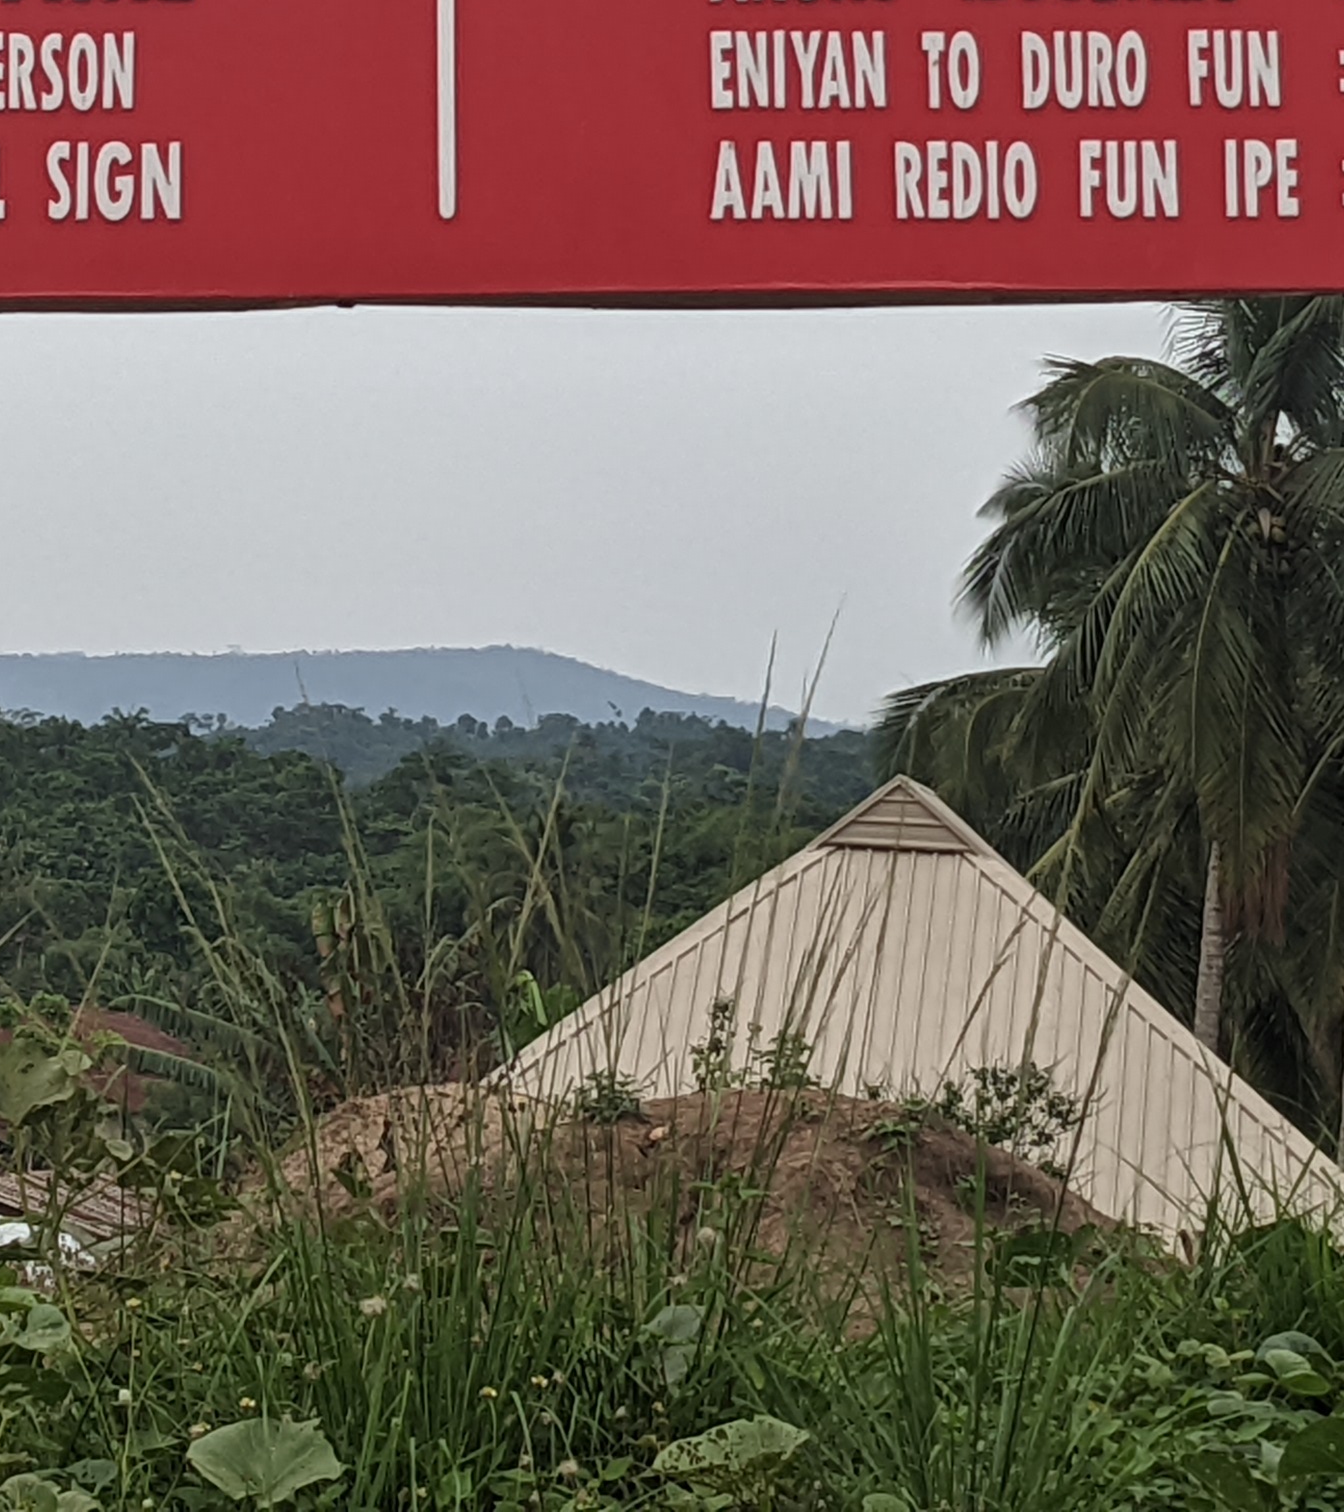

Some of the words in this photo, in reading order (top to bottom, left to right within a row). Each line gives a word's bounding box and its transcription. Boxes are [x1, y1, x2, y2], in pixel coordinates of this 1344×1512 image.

[710, 30, 887, 109] ENIYAN
[921, 31, 981, 110] TO
[1021, 30, 1148, 110] DURO
[1188, 29, 1281, 109] FUN
[46, 141, 182, 222] SIGN
[710, 140, 853, 220] AAMI
[894, 140, 1038, 220] REDIO
[1080, 139, 1180, 219] FUN
[1225, 139, 1300, 218] IPE
